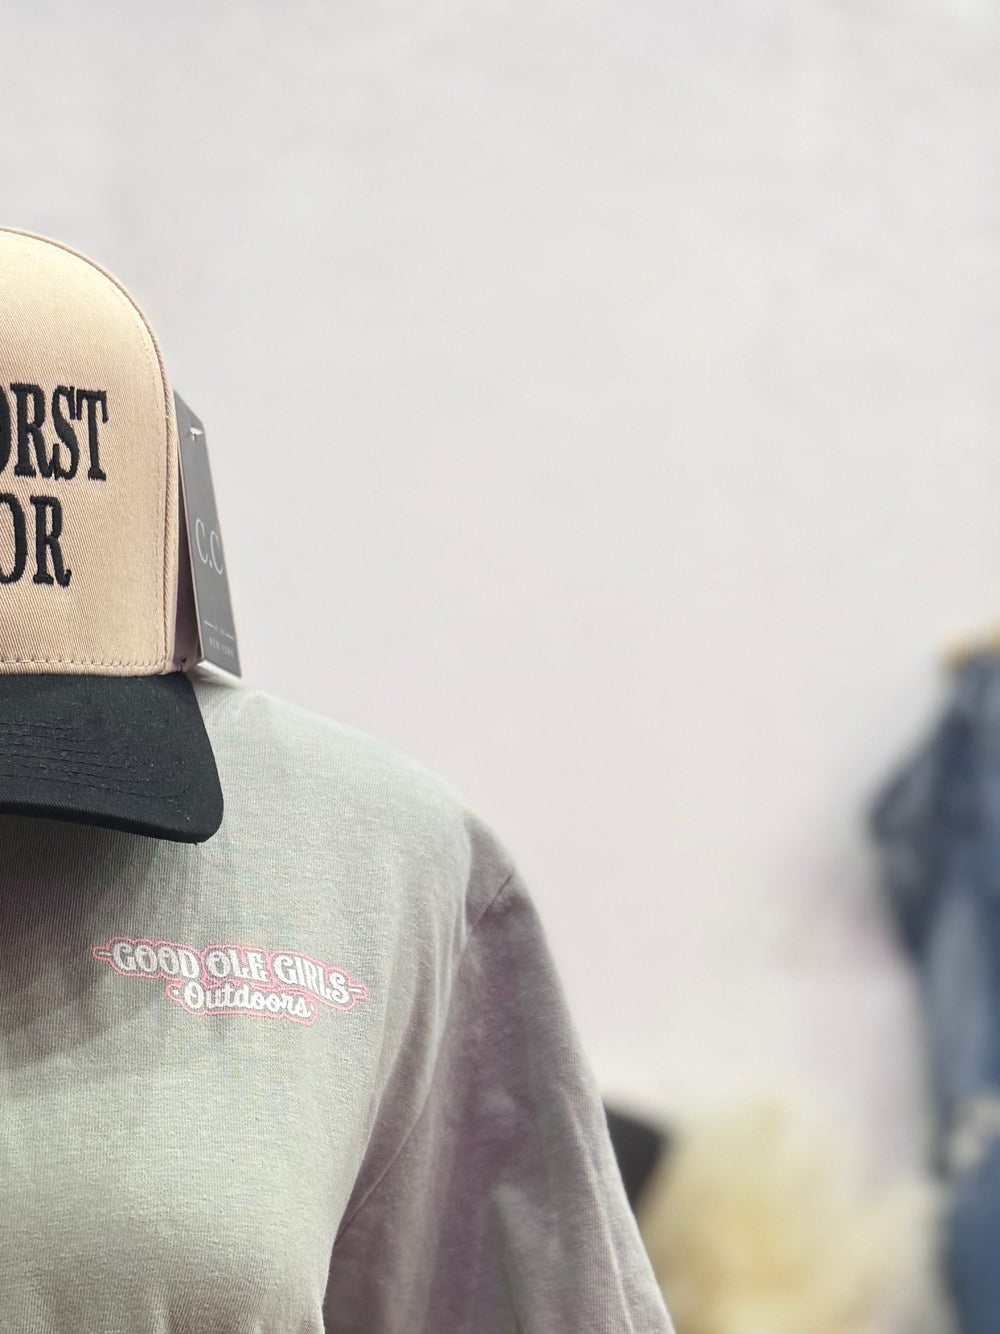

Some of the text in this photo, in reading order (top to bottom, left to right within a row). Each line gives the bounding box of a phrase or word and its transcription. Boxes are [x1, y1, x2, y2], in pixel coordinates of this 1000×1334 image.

[112, 941, 350, 1005] GOOD OLE GIRLS
[182, 980, 312, 1018] Outdoors
